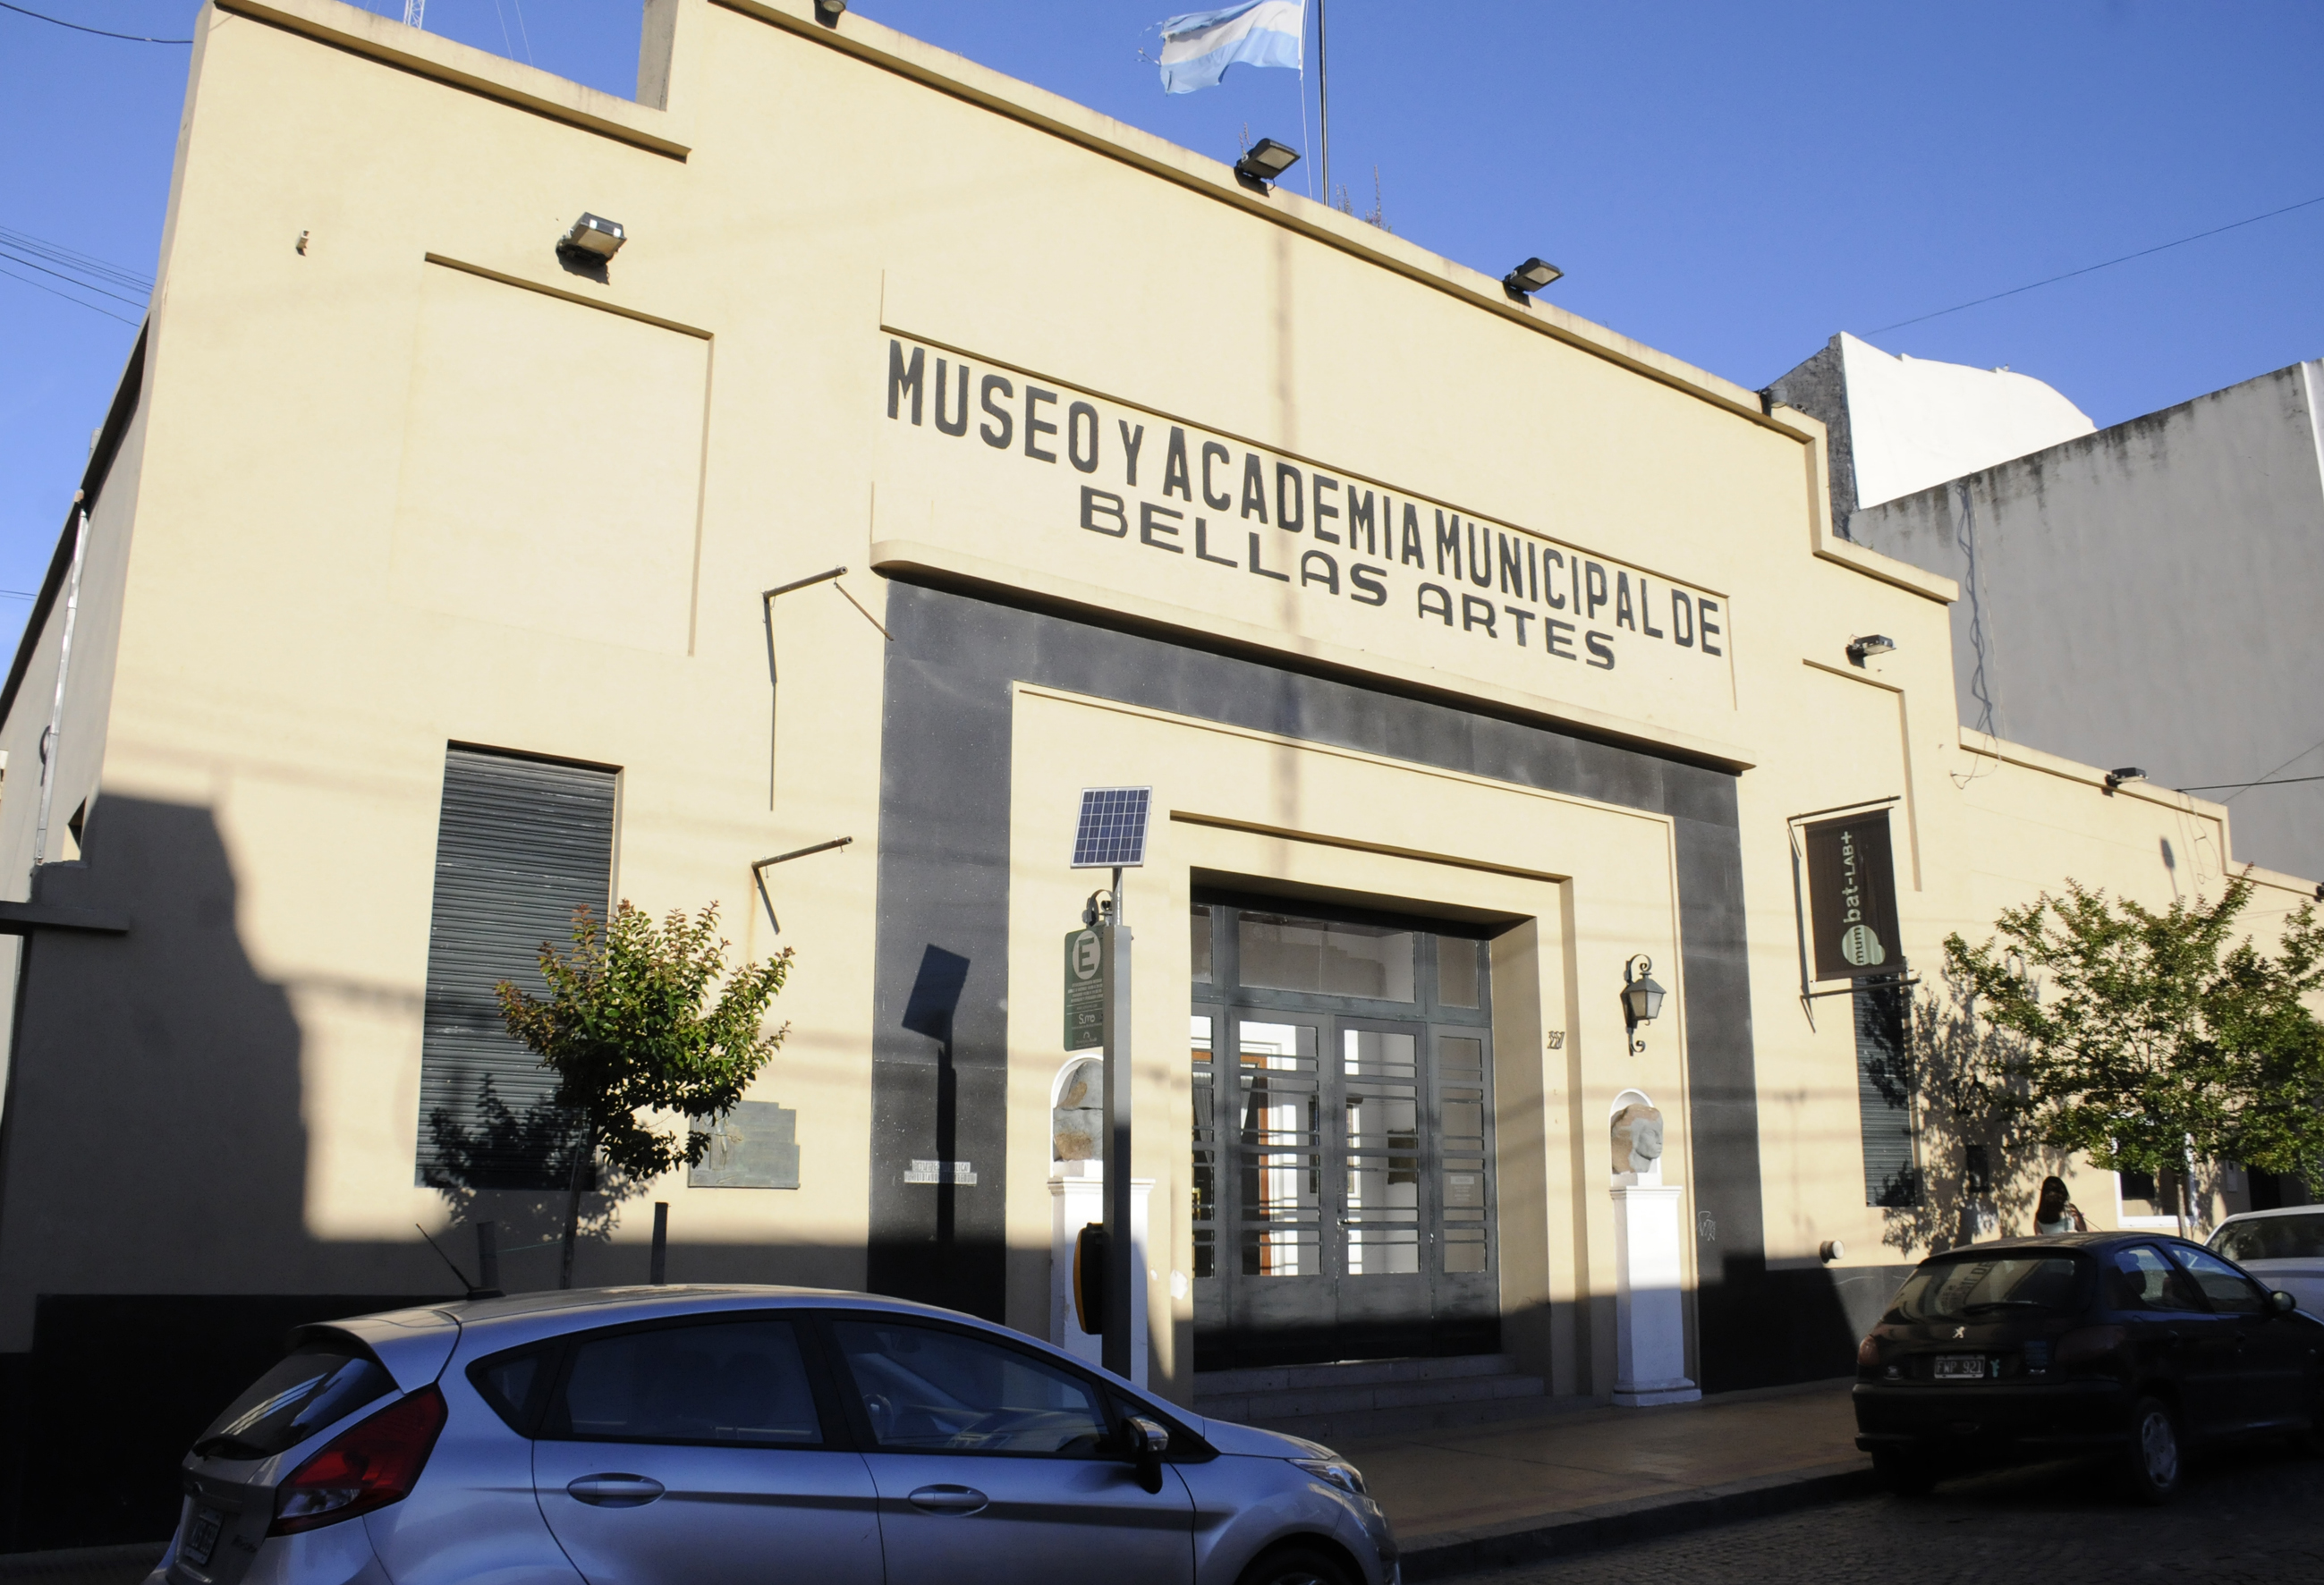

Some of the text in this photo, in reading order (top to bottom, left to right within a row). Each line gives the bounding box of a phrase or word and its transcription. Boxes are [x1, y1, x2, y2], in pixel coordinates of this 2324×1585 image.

[887, 339, 1723, 657] MUSEO Y ACADEMIA MUNICIPAL DE
[1081, 485, 1616, 671] BELLAS ARTES
[1078, 937, 1095, 973] E
[1963, 1360, 1982, 1374] 921
